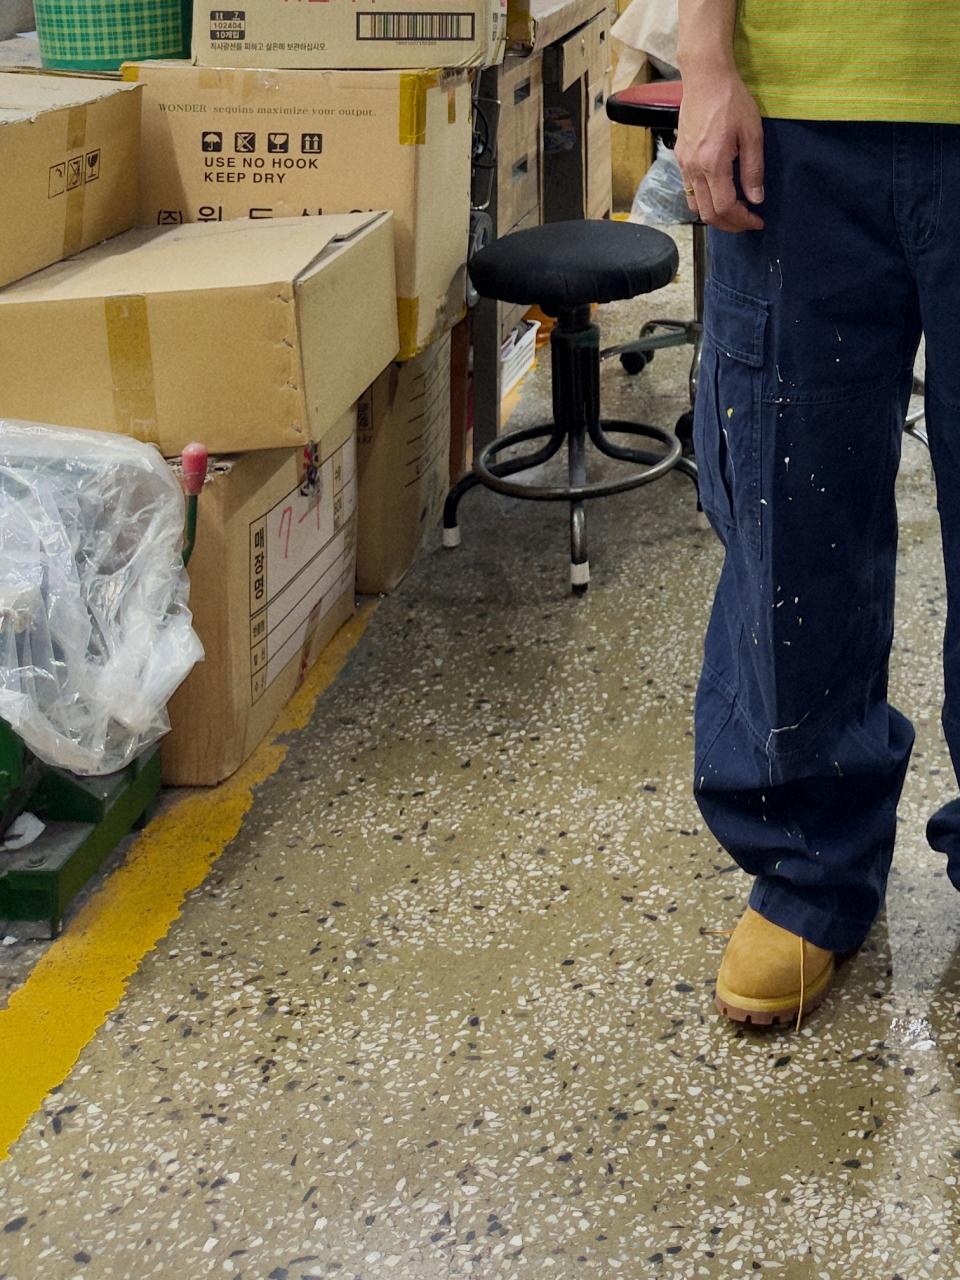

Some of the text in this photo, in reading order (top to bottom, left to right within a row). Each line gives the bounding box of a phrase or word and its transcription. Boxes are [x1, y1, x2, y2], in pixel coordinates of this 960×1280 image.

[158, 103, 207, 114] WONDER
[257, 106, 307, 115] maximize
[311, 108, 336, 117] your
[204, 157, 319, 169] USE NO HOOK
[204, 172, 287, 184] KEEP DRY
